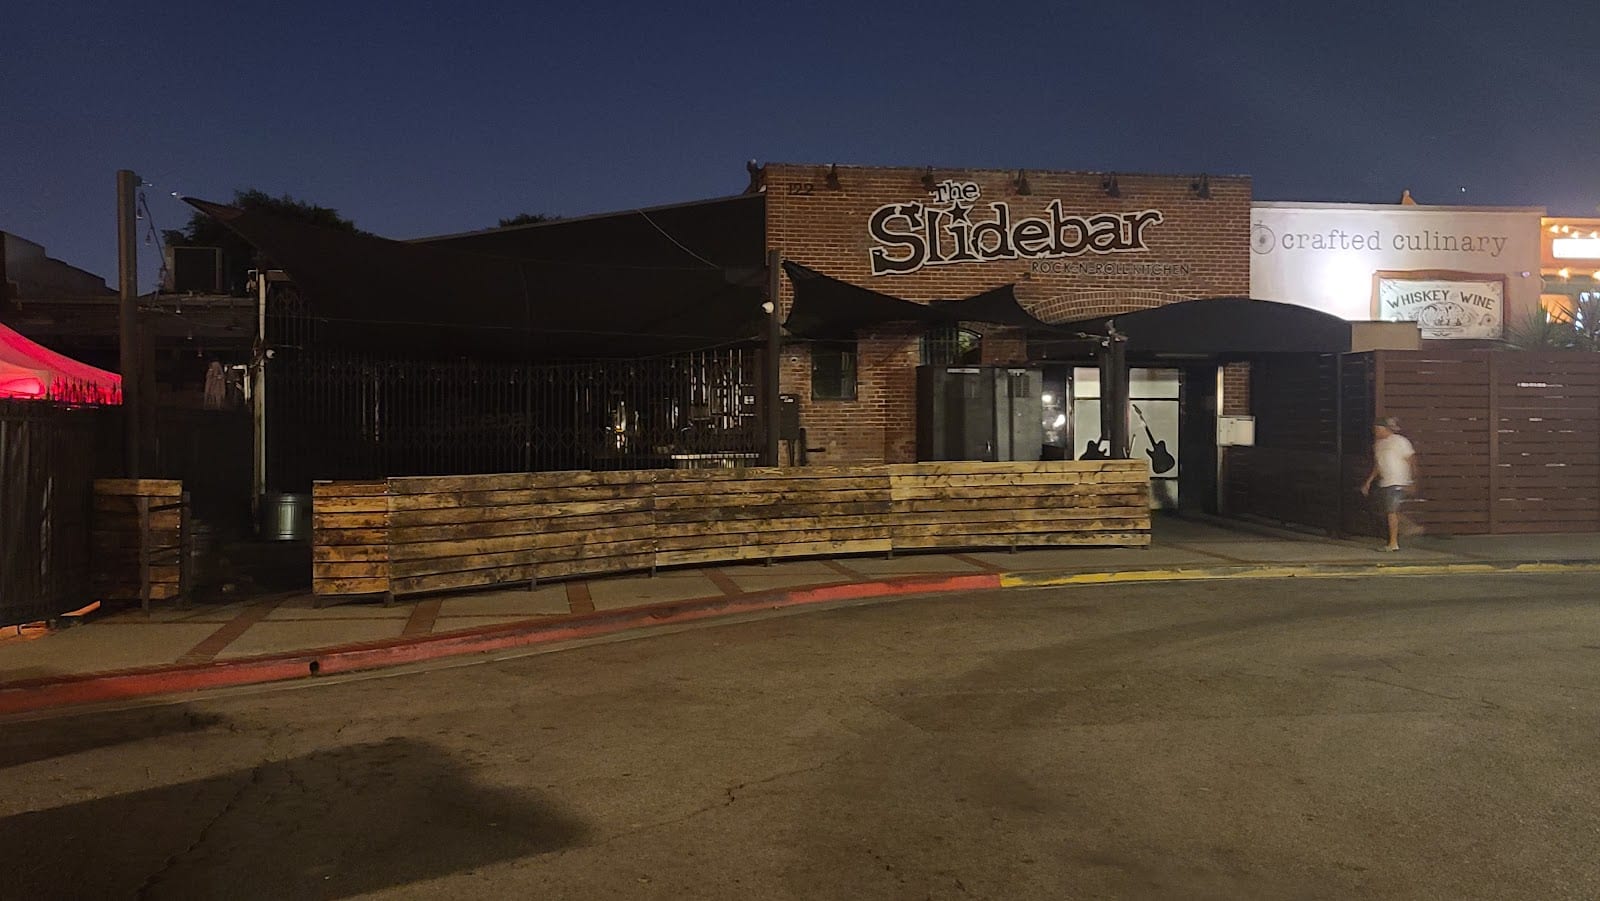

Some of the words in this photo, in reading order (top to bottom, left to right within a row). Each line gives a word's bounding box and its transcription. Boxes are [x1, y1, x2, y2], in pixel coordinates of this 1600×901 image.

[788, 183, 815, 196] 122
[928, 179, 981, 204] The
[868, 198, 1164, 276] Slidebar
[1281, 229, 1382, 251] crafted
[1392, 230, 1508, 257] culinary
[1133, 263, 1190, 276] KITCHEN
[1386, 290, 1450, 309] WHISKEY
[1460, 291, 1496, 310] WINE
